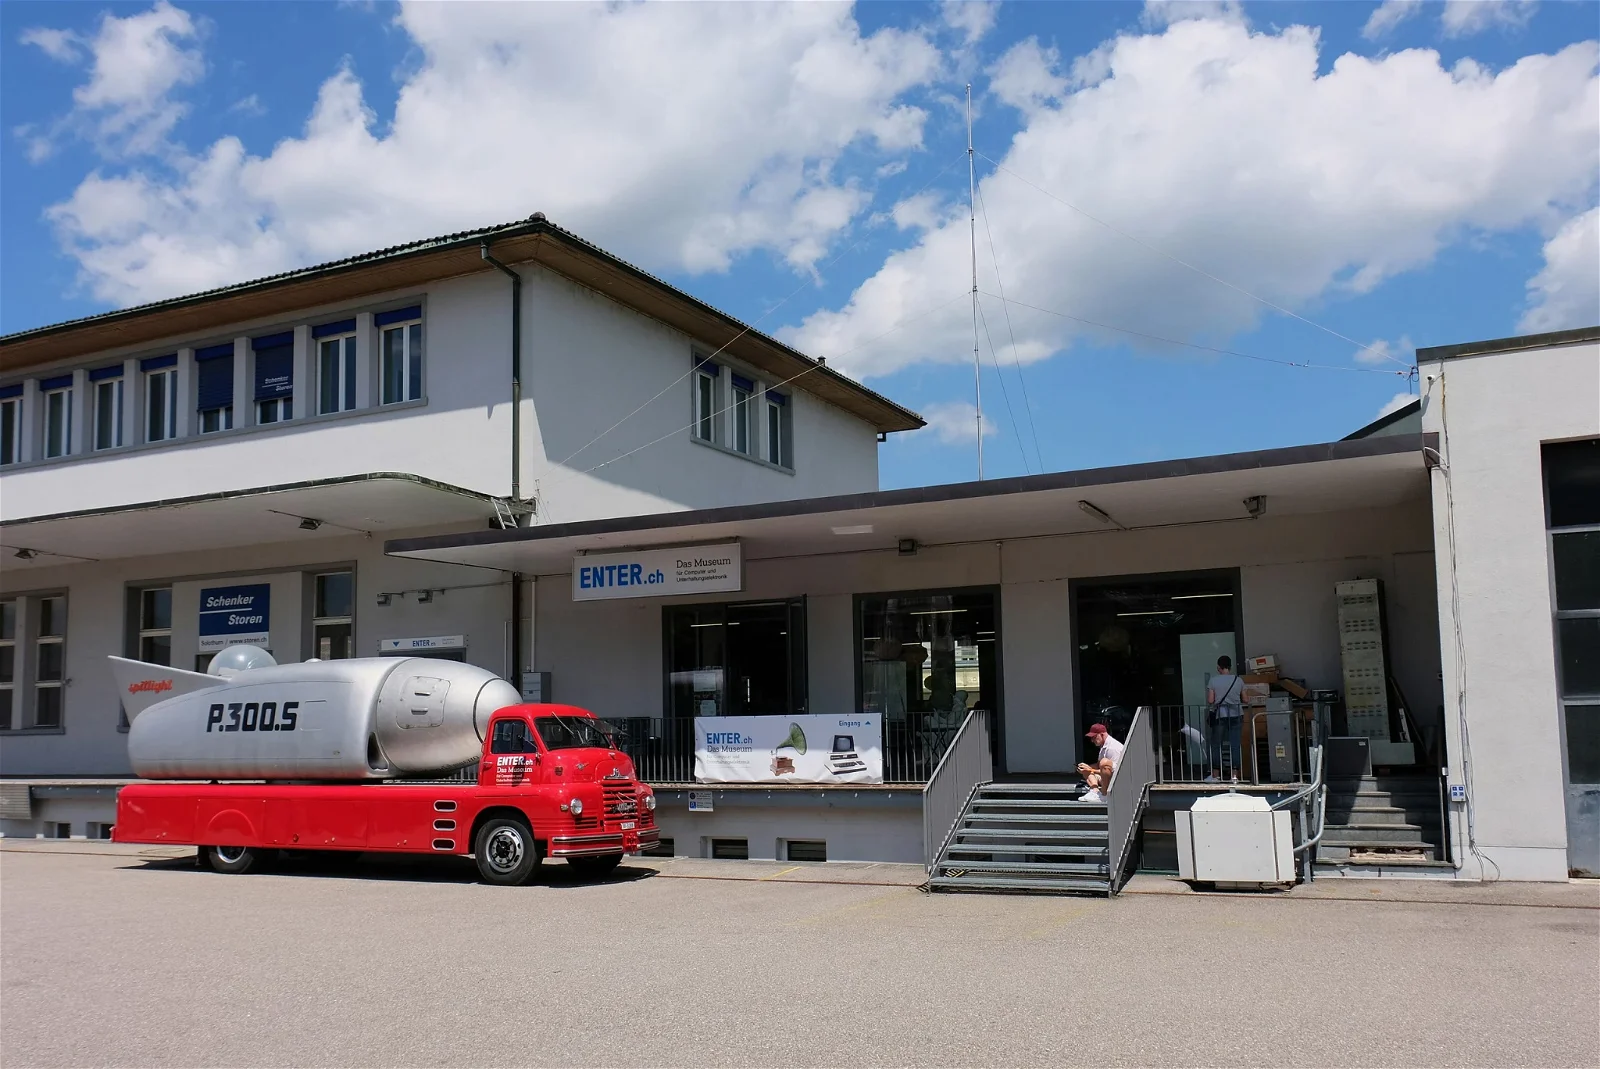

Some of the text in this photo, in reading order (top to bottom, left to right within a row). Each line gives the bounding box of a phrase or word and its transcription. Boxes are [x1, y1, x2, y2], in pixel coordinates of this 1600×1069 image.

[676, 557, 731, 568] Das Museum
[580, 563, 664, 588] ENTER.ch
[206, 594, 254, 608] Schenker
[228, 614, 263, 625] Storen
[206, 701, 299, 733] P.300.S
[706, 732, 753, 745] ENTER.ch
[707, 745, 753, 753] Das Museum
